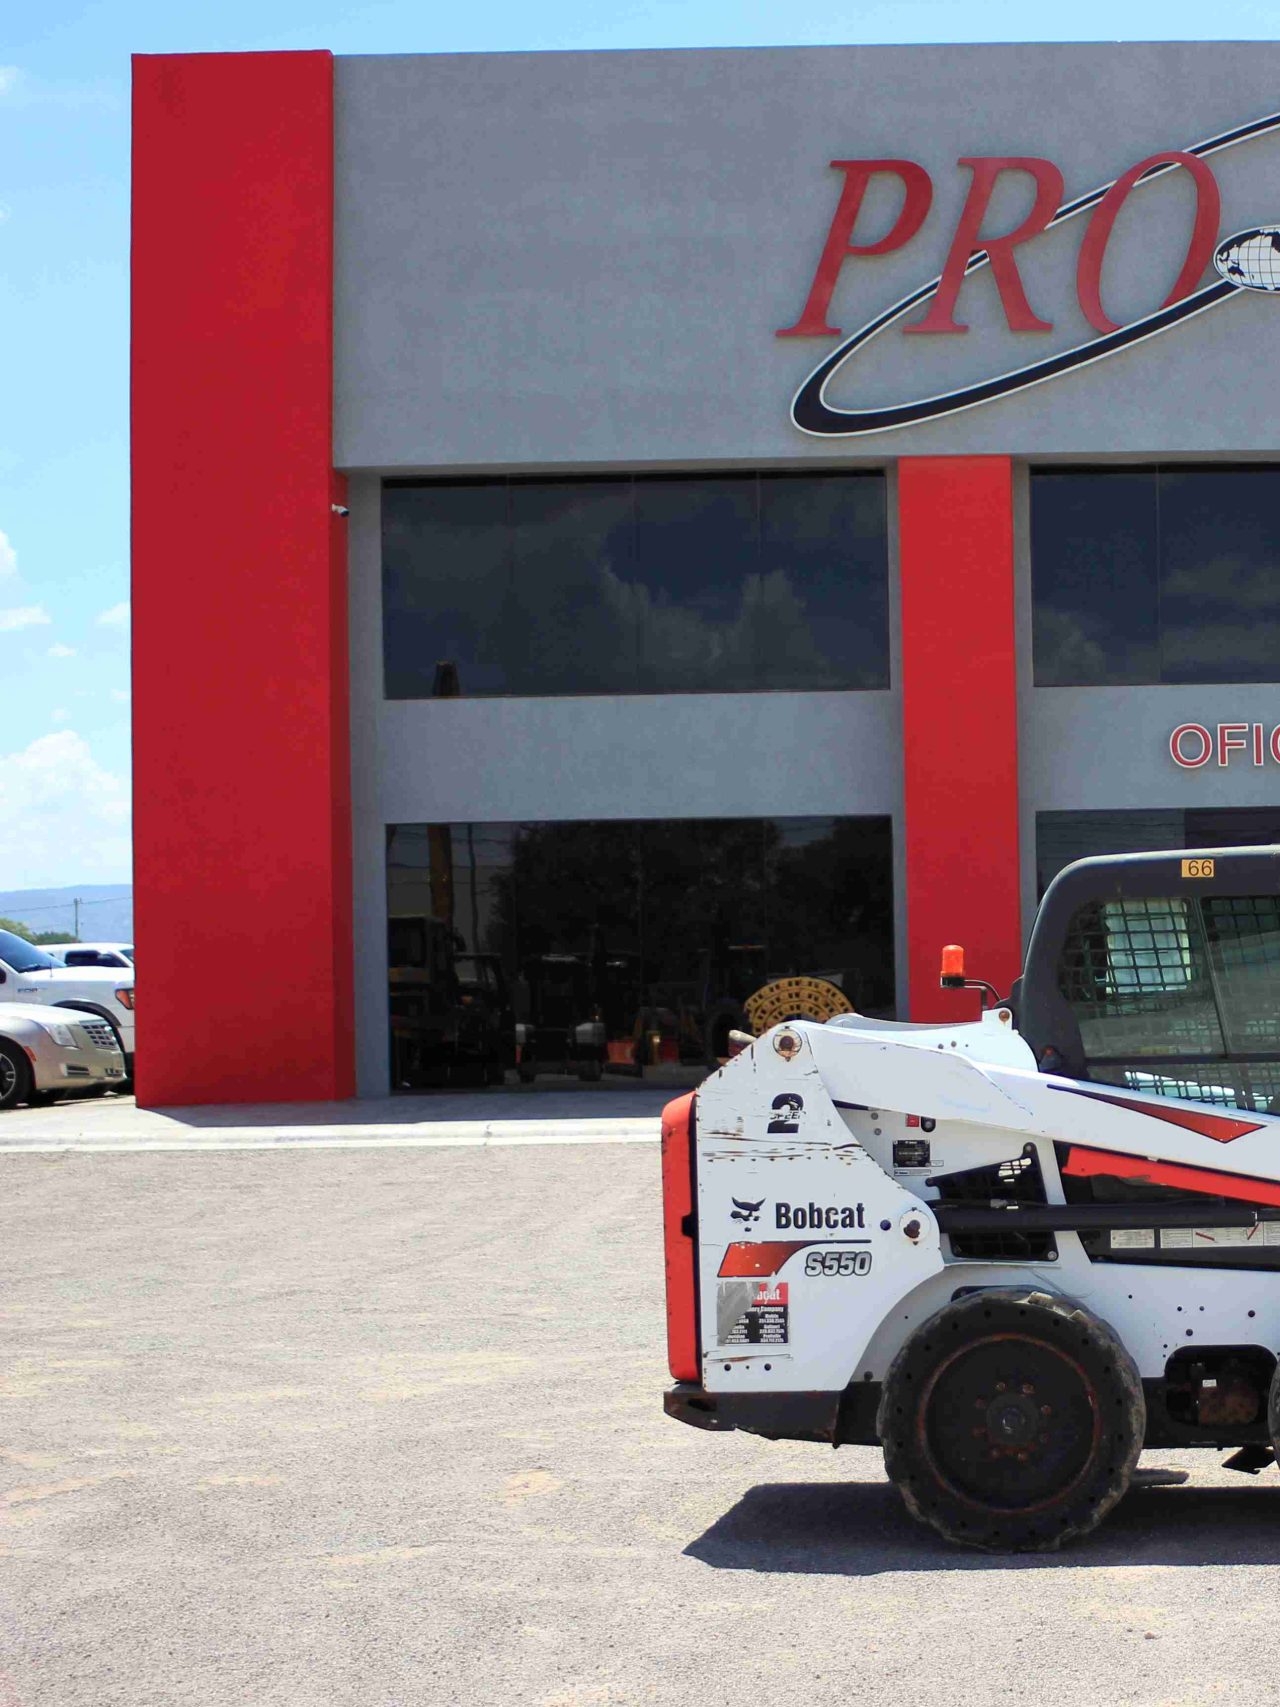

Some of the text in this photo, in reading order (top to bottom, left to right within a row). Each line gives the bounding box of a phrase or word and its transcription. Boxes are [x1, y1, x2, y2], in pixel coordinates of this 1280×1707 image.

[1188, 860, 1214, 877] 66
[767, 1093, 804, 1134] 2
[776, 1202, 865, 1229] Bobcat
[805, 1251, 872, 1277] S550
